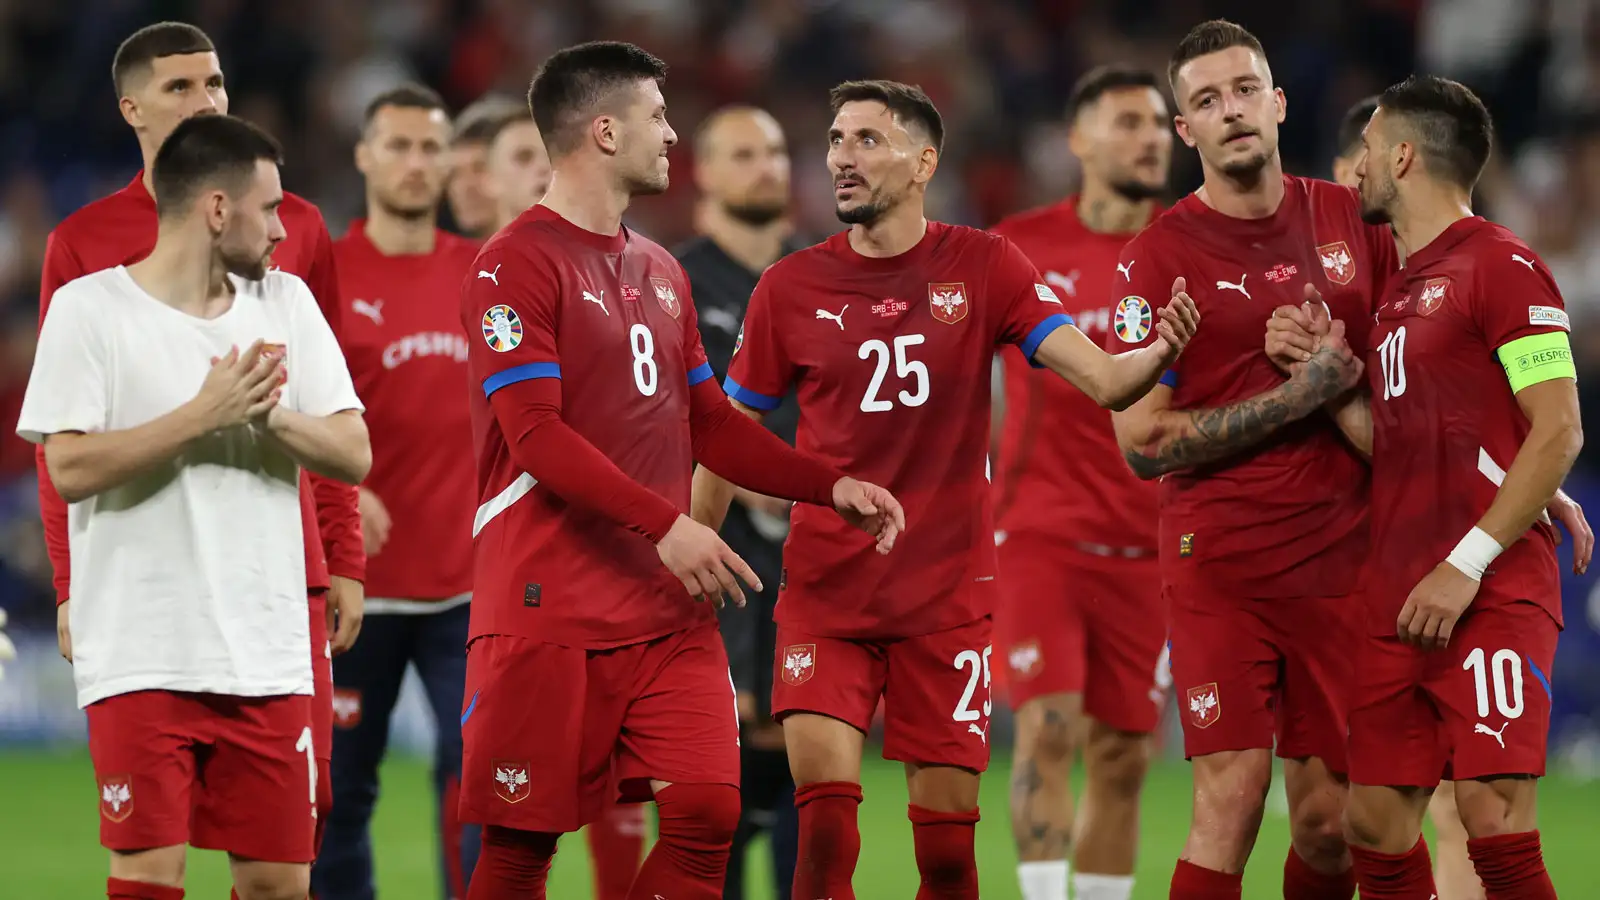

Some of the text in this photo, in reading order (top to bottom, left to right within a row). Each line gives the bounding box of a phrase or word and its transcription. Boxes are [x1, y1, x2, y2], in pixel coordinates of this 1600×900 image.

[871, 301, 907, 314] SRB-ENG
[1264, 265, 1298, 281] SRB-ENG
[630, 323, 658, 397] 8
[858, 333, 930, 413] 25
[1376, 326, 1407, 401] 10
[1462, 647, 1525, 719] 10
